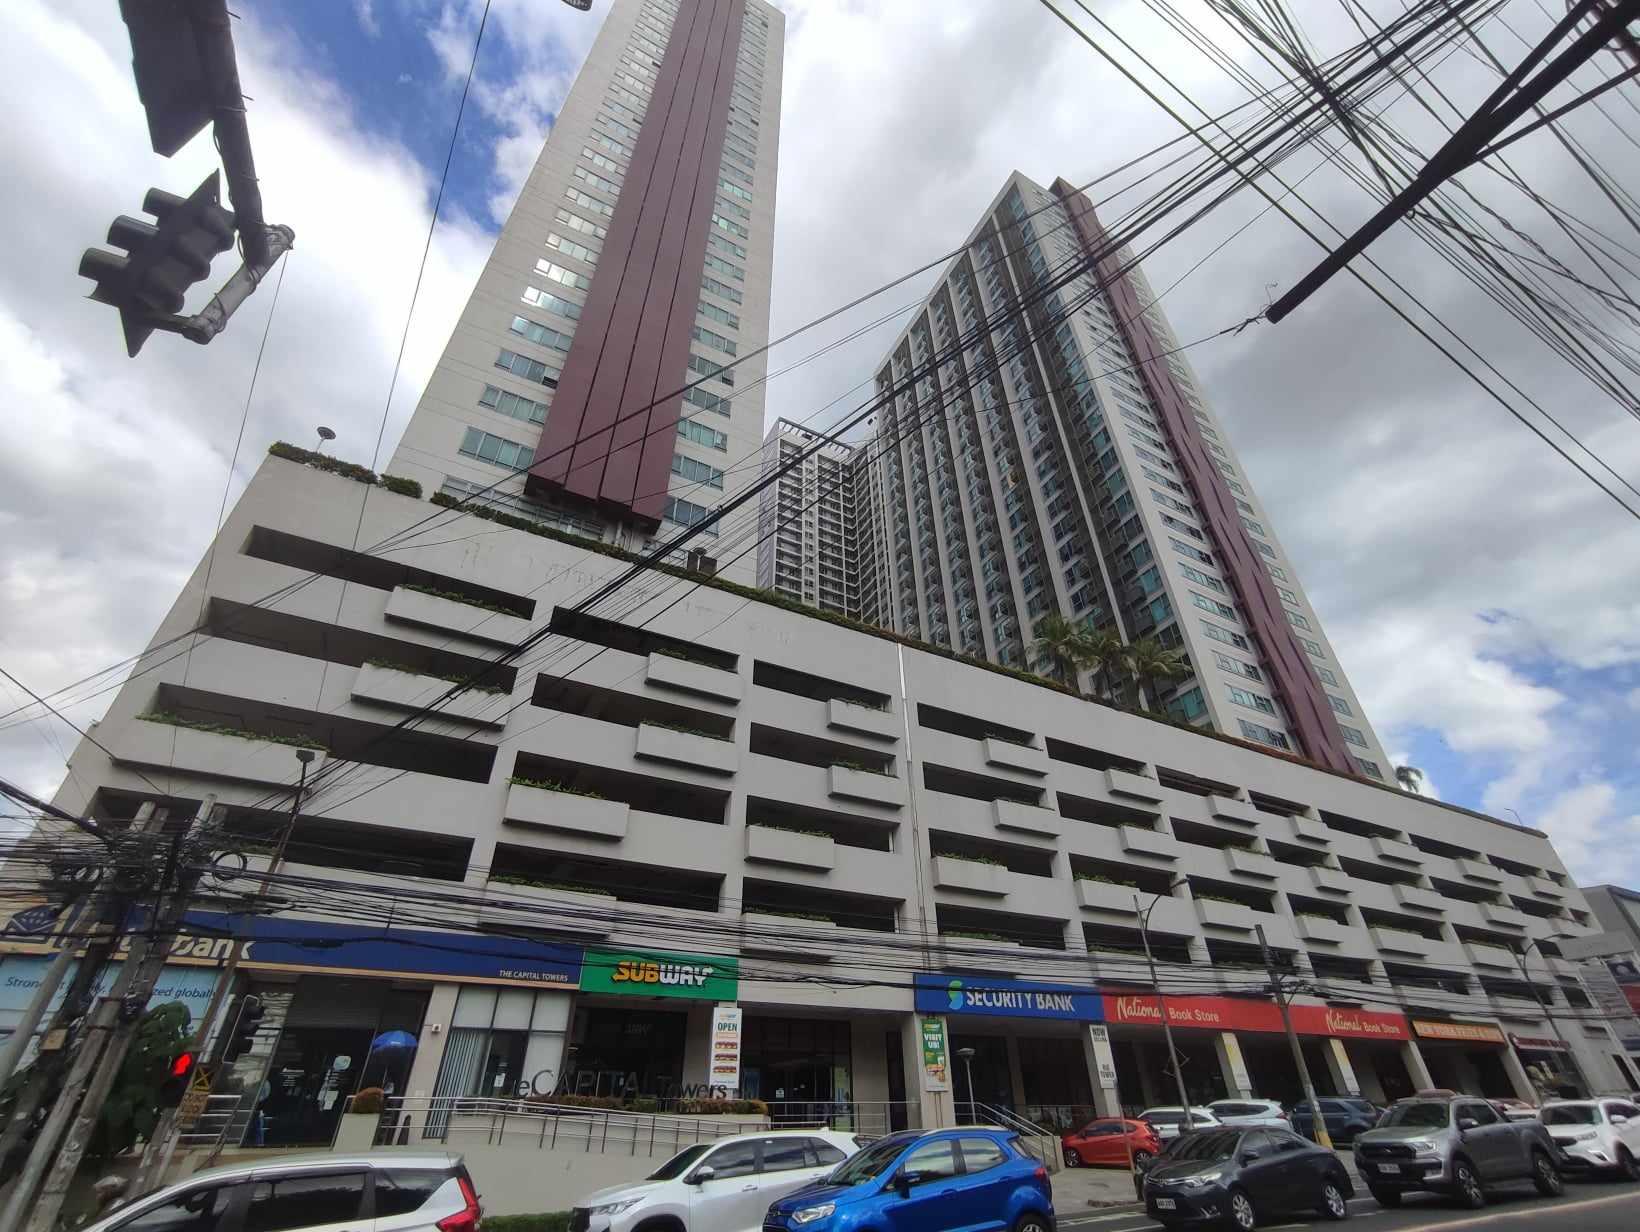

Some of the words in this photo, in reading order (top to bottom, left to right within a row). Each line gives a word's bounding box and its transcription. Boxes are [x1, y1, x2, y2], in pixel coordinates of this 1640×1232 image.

[500, 969, 513, 978] THE
[513, 970, 540, 980] CAPITAL
[543, 972, 569, 983] TOWERS
[612, 960, 714, 987] SUBWAY
[966, 986, 1032, 1009] SECURITY
[1036, 990, 1076, 1013] BANK
[1116, 996, 1162, 1020] Nationa
[1168, 1007, 1192, 1021] Book
[1194, 1008, 1220, 1023] Store
[717, 1022, 738, 1032] OPEN
[1325, 1008, 1361, 1034] National
[1362, 1021, 1381, 1033] Book
[1382, 1023, 1401, 1035] Store
[923, 1033, 943, 1041] VISIT
